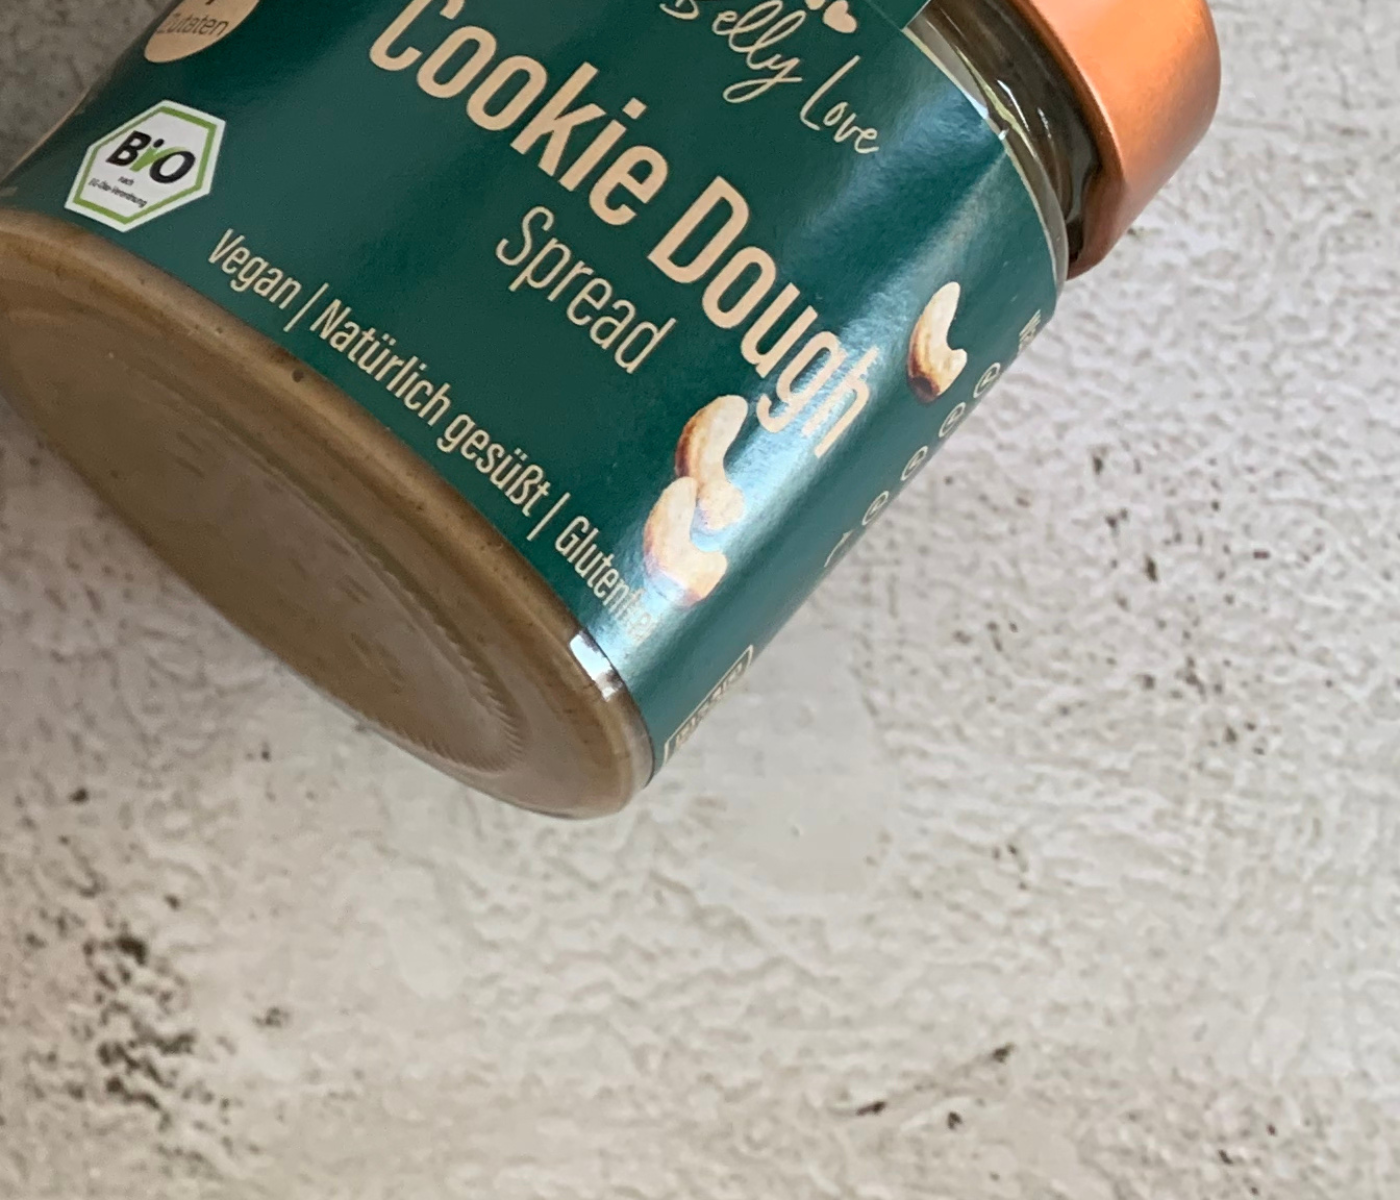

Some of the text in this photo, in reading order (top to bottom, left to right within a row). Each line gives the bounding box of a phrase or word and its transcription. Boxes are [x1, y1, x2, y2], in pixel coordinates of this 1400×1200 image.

[800, 55, 879, 154] Love
[207, 227, 303, 310] Vegan
[309, 298, 452, 428] Natürlich
[436, 413, 550, 517] gesüßt
[495, 206, 677, 375] Spread
[647, 176, 879, 459] Dough
